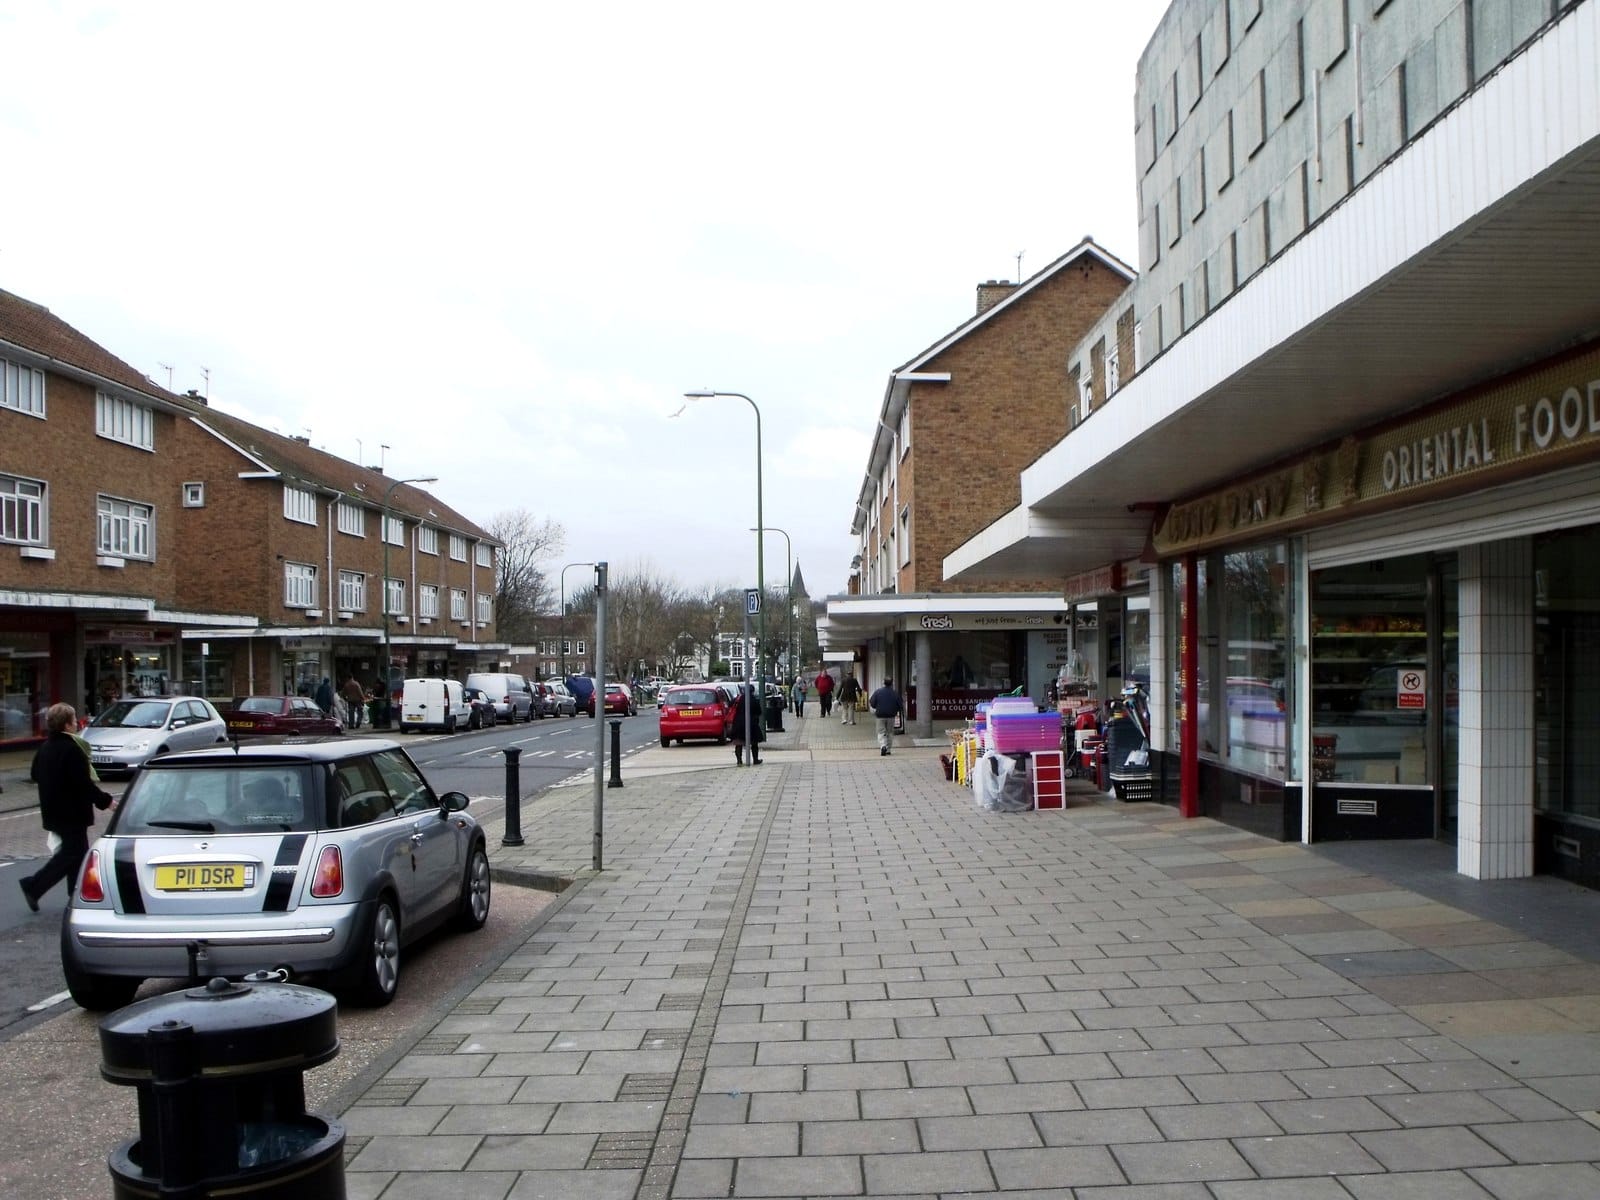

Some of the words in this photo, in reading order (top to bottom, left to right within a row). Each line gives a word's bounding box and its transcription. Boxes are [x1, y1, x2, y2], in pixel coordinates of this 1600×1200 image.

[1383, 417, 1495, 490] ORIENTAL
[921, 615, 953, 629] fresh
[201, 868, 235, 885] DSR
